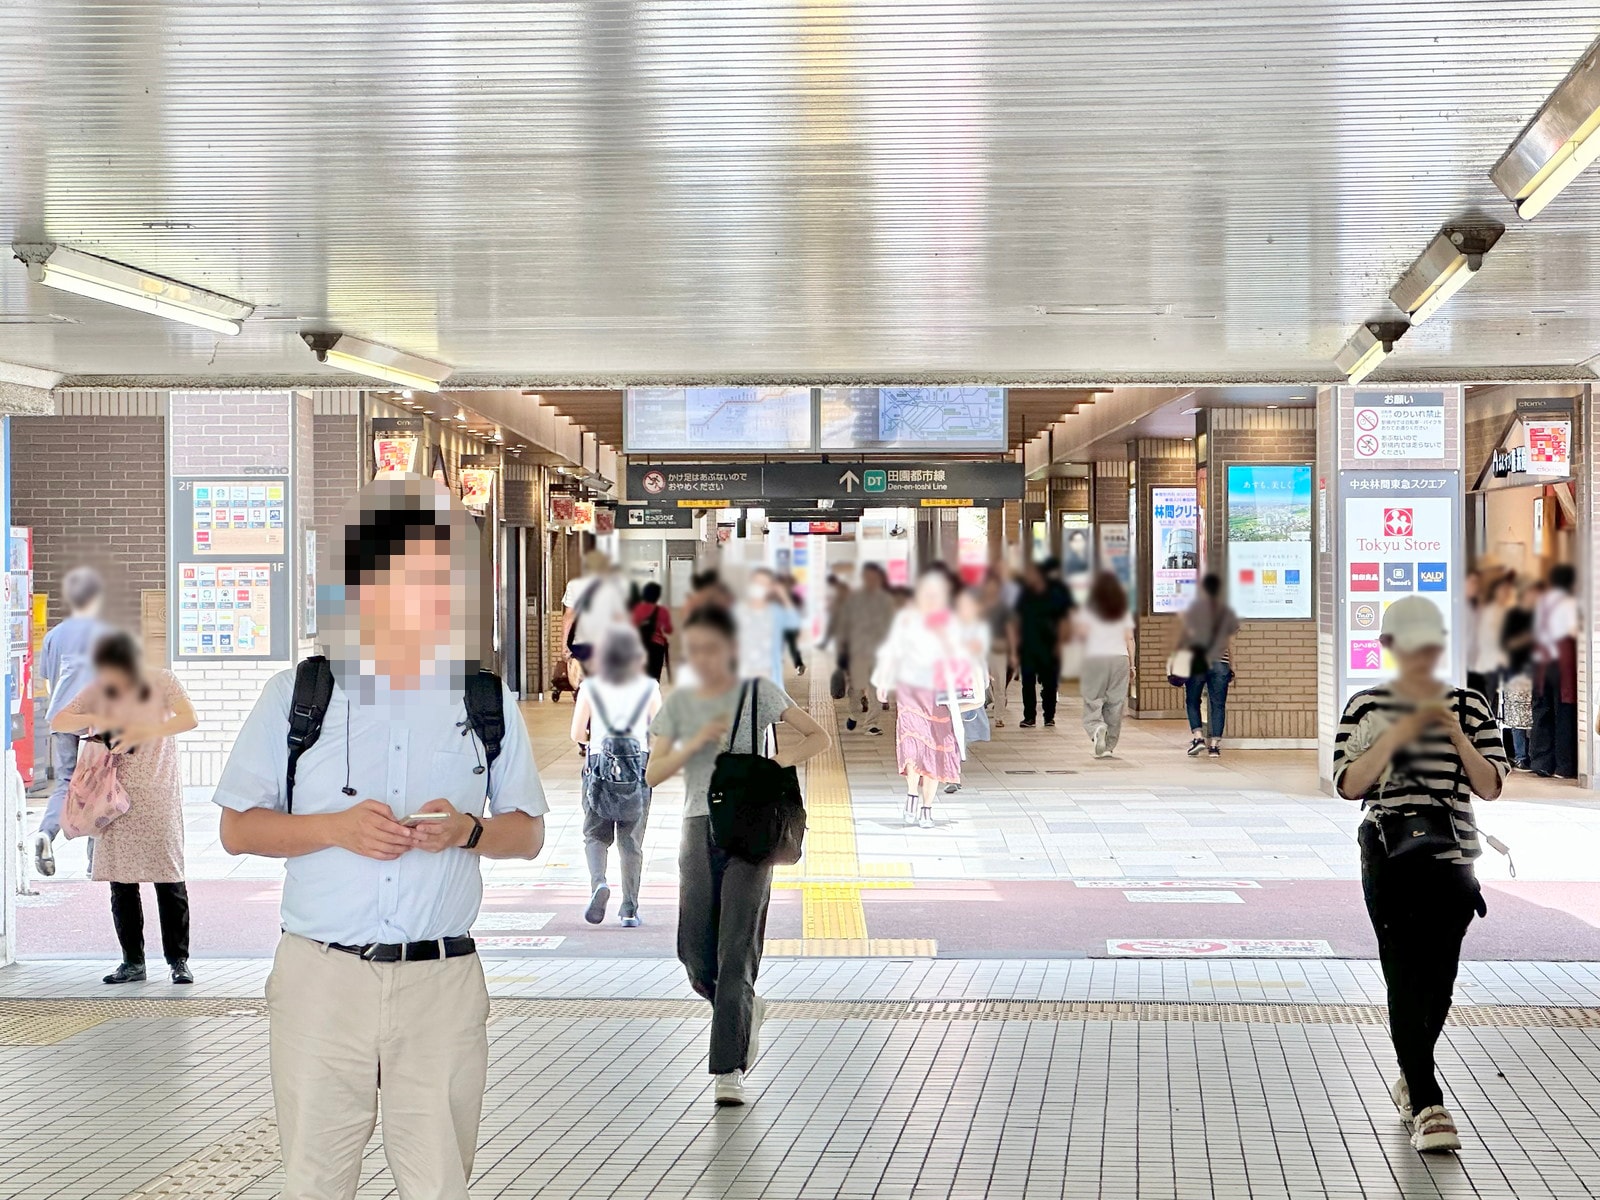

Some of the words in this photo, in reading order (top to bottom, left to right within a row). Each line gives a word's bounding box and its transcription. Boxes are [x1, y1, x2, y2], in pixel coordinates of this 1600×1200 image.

[1384, 395, 1414, 405] お願い
[1394, 410, 1442, 418] のりいれ禁止
[668, 473, 747, 481] かけ足はあぶないので
[888, 470, 946, 482] 田園都市線
[178, 481, 192, 490] 2F
[867, 477, 882, 486] DT
[1350, 479, 1447, 490] 中央林間東急スクエア
[668, 483, 724, 491] おやめください
[1357, 538, 1400, 554] Tokyu
[1404, 537, 1441, 551] Store
[272, 563, 284, 572] 1F
[1420, 572, 1443, 580] KALDI
